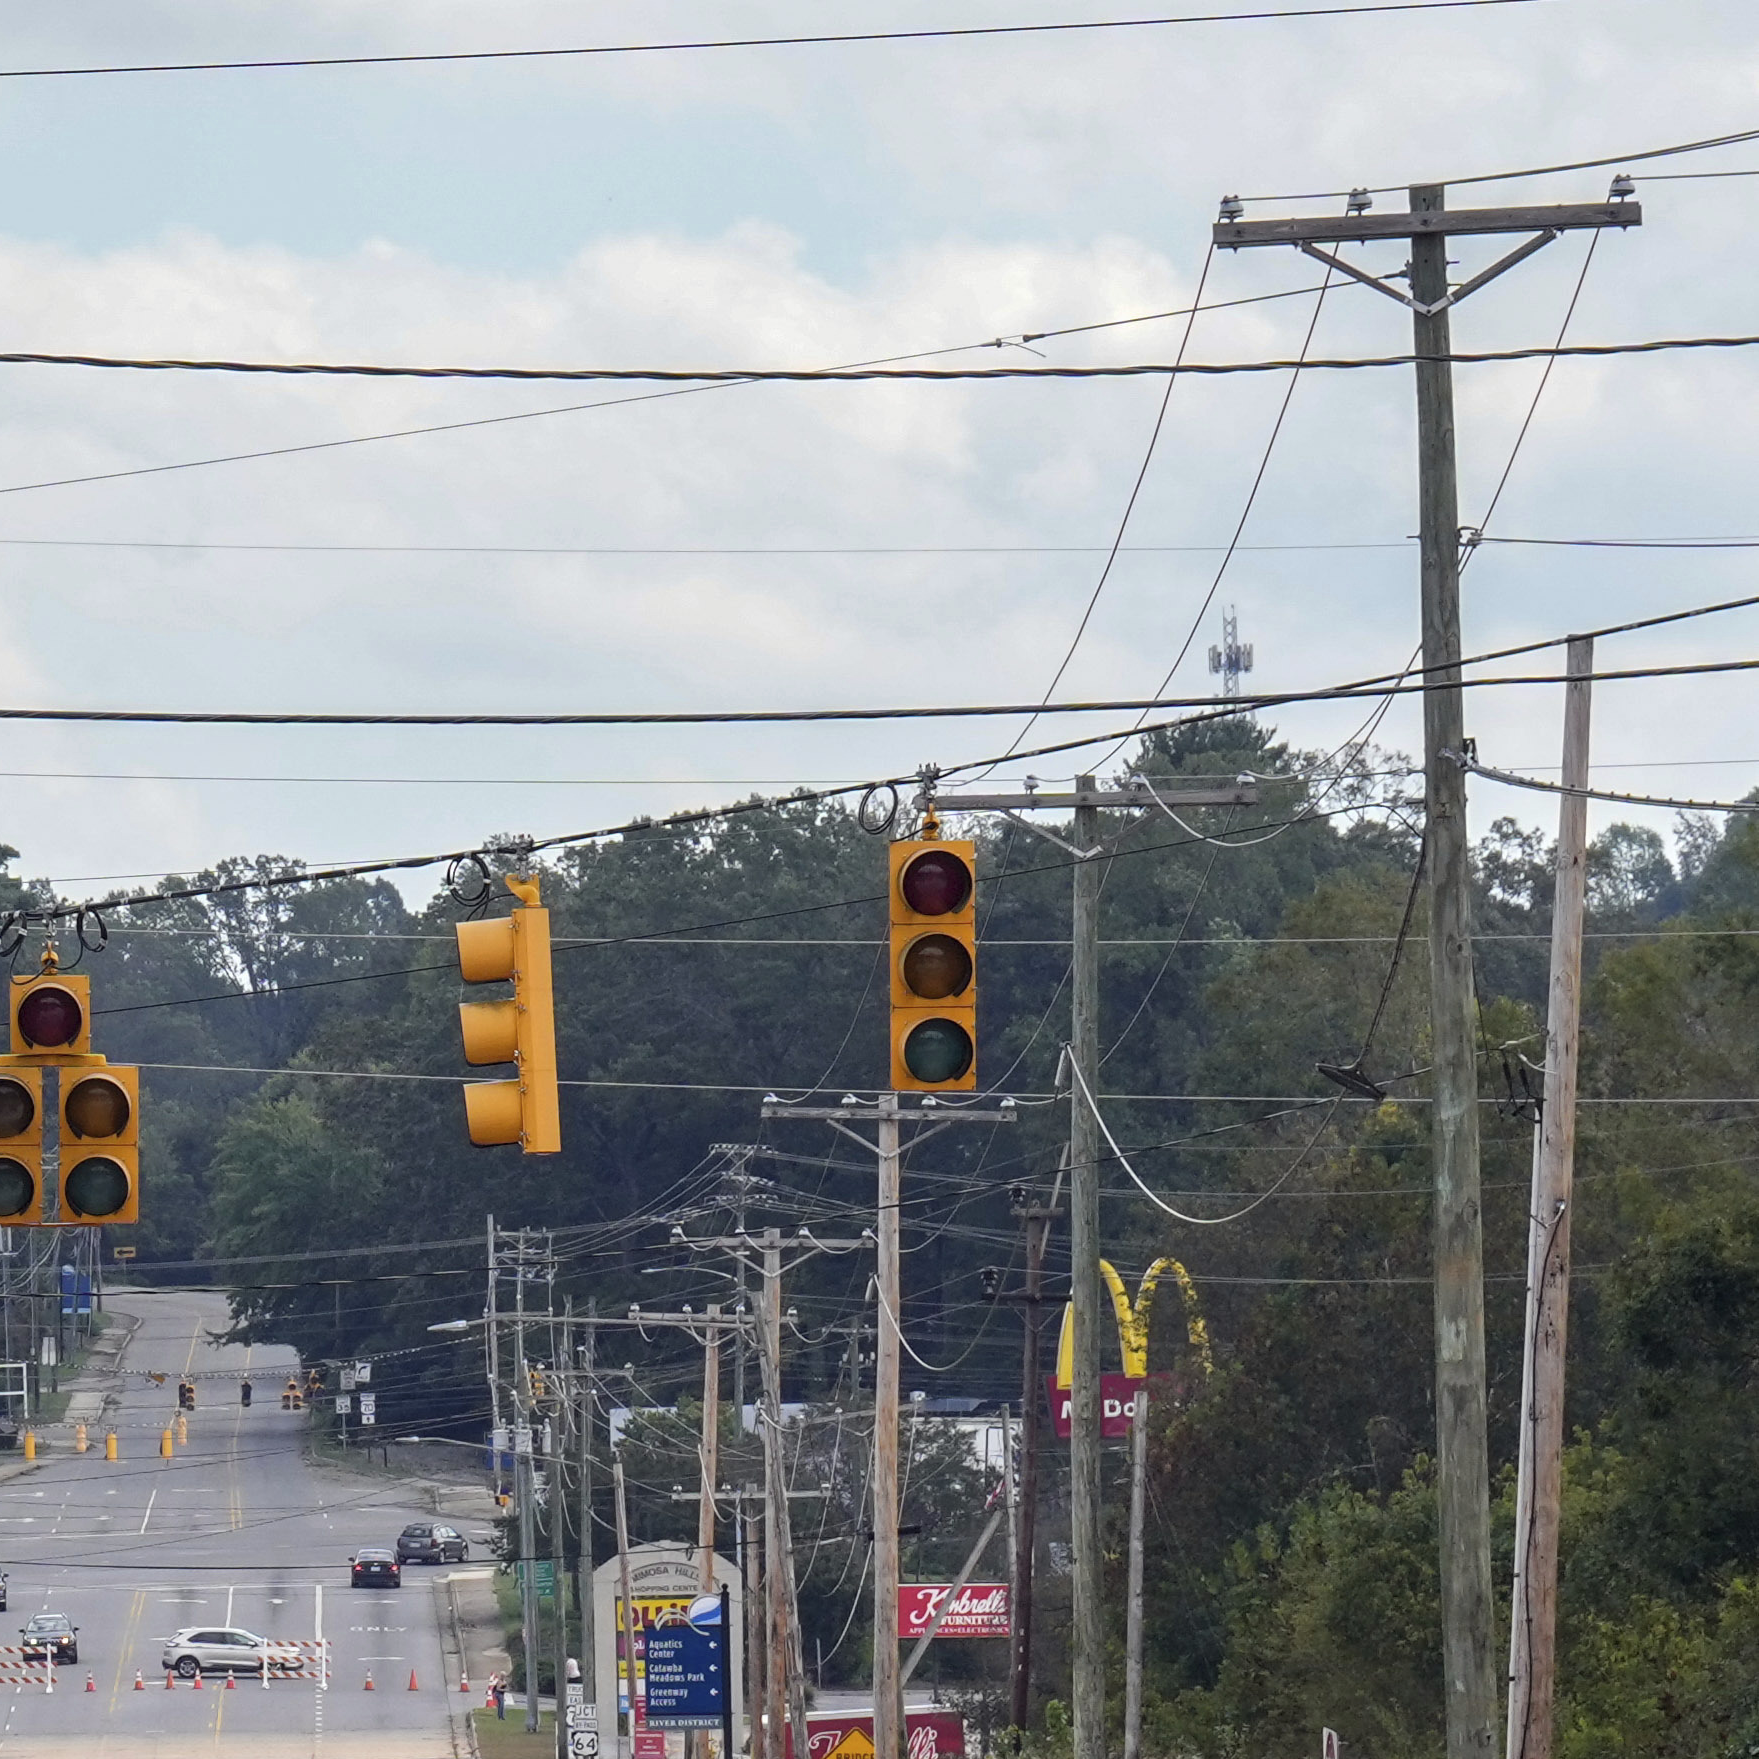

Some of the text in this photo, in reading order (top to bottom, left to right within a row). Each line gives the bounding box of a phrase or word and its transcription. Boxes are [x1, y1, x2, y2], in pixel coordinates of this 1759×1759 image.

[910, 1588, 1007, 1624] Kmbrell's
[940, 1615, 1008, 1625] FURNITURE
[649, 1640, 683, 1650] Aquatics
[649, 1650, 675, 1658] Center
[649, 1664, 683, 1673] Catawba
[649, 1673, 705, 1682] Meadows Park
[650, 1688, 688, 1698] Greenway
[650, 1698, 677, 1706] Access
[576, 1706, 595, 1717] JCT
[649, 1718, 719, 1727] RIVER DISTRICT
[575, 1738, 595, 1751] 64
